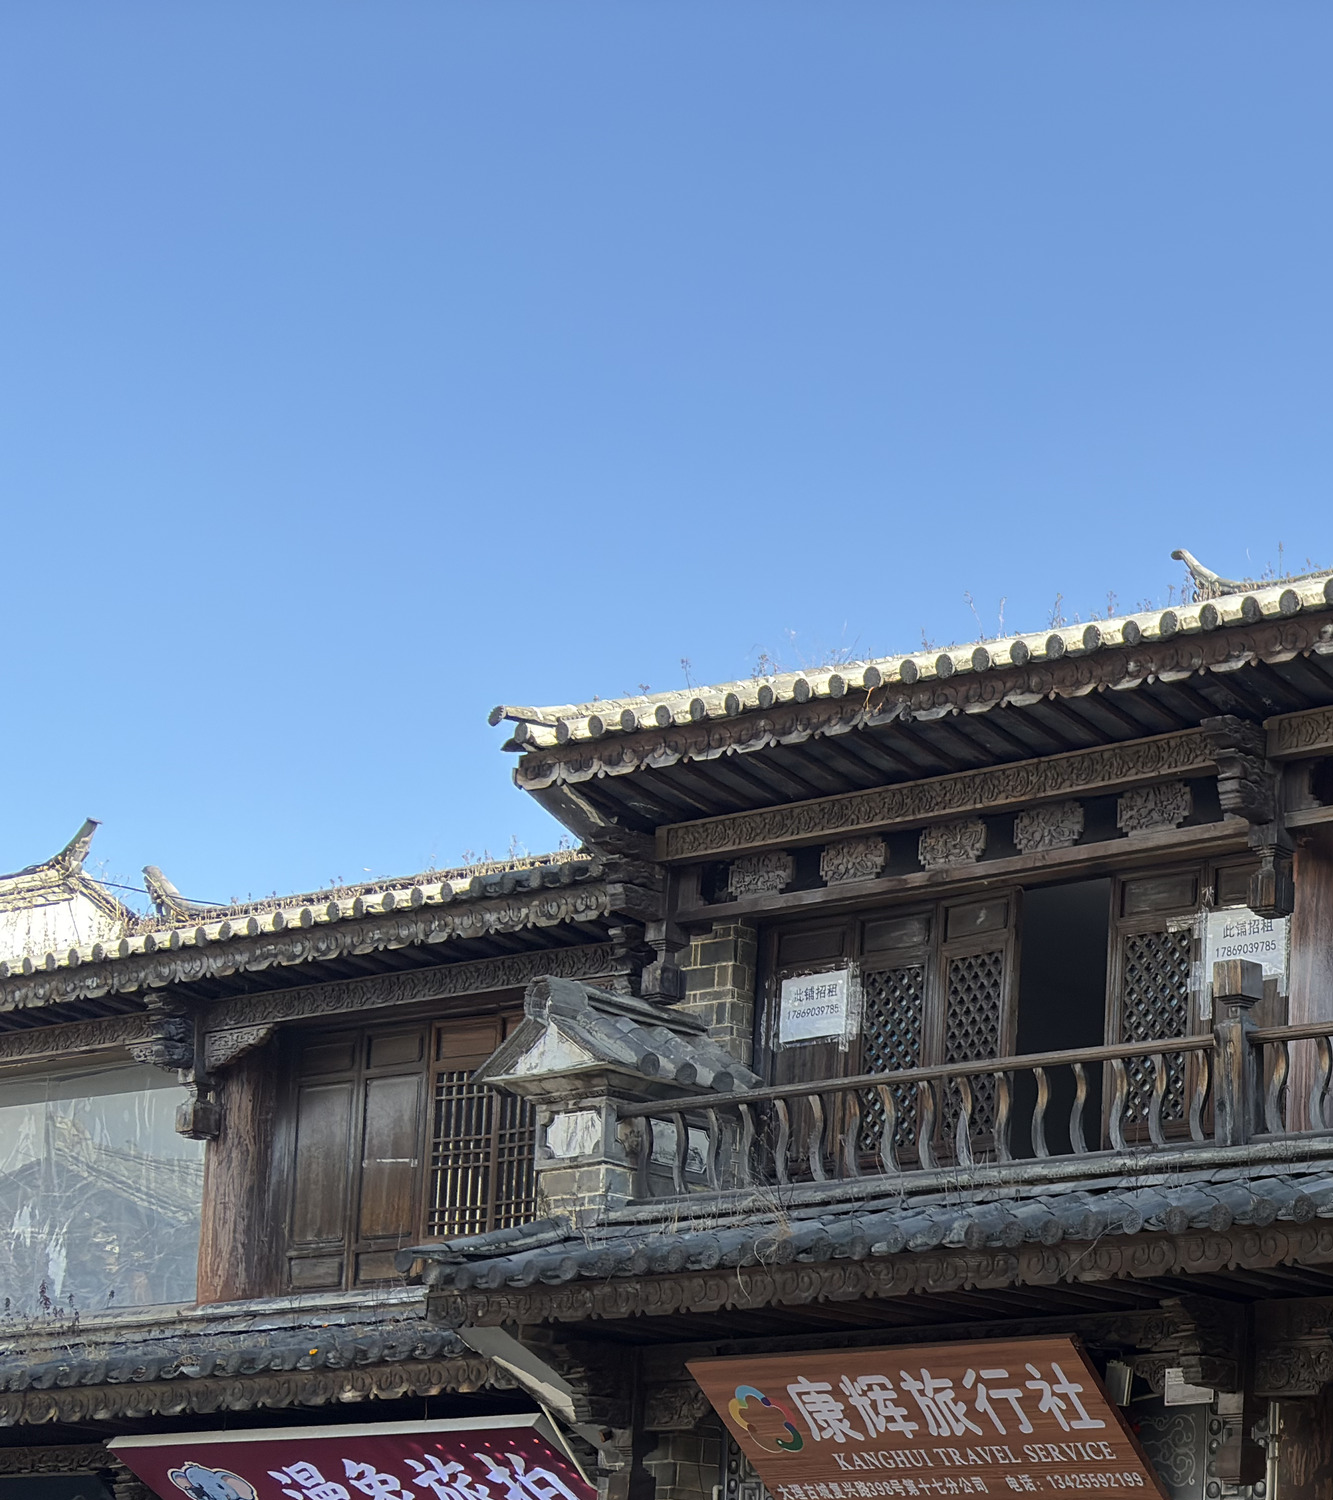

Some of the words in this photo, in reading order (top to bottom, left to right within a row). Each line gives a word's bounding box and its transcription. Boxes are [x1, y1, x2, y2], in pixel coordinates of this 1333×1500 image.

[1223, 919, 1275, 939] 此铺招租
[1215, 940, 1277, 957] 17869039785
[794, 984, 838, 1002] 此铺招租
[787, 1004, 840, 1020] 17869039785
[787, 1362, 1106, 1443] 康辉旅行社
[832, 1448, 934, 1471] KANGHUI
[933, 1444, 1022, 1467] TRAVEL
[1021, 1441, 1117, 1463] SERVICE
[777, 1475, 990, 1500] 大理古城复兴路398号第十七分公司
